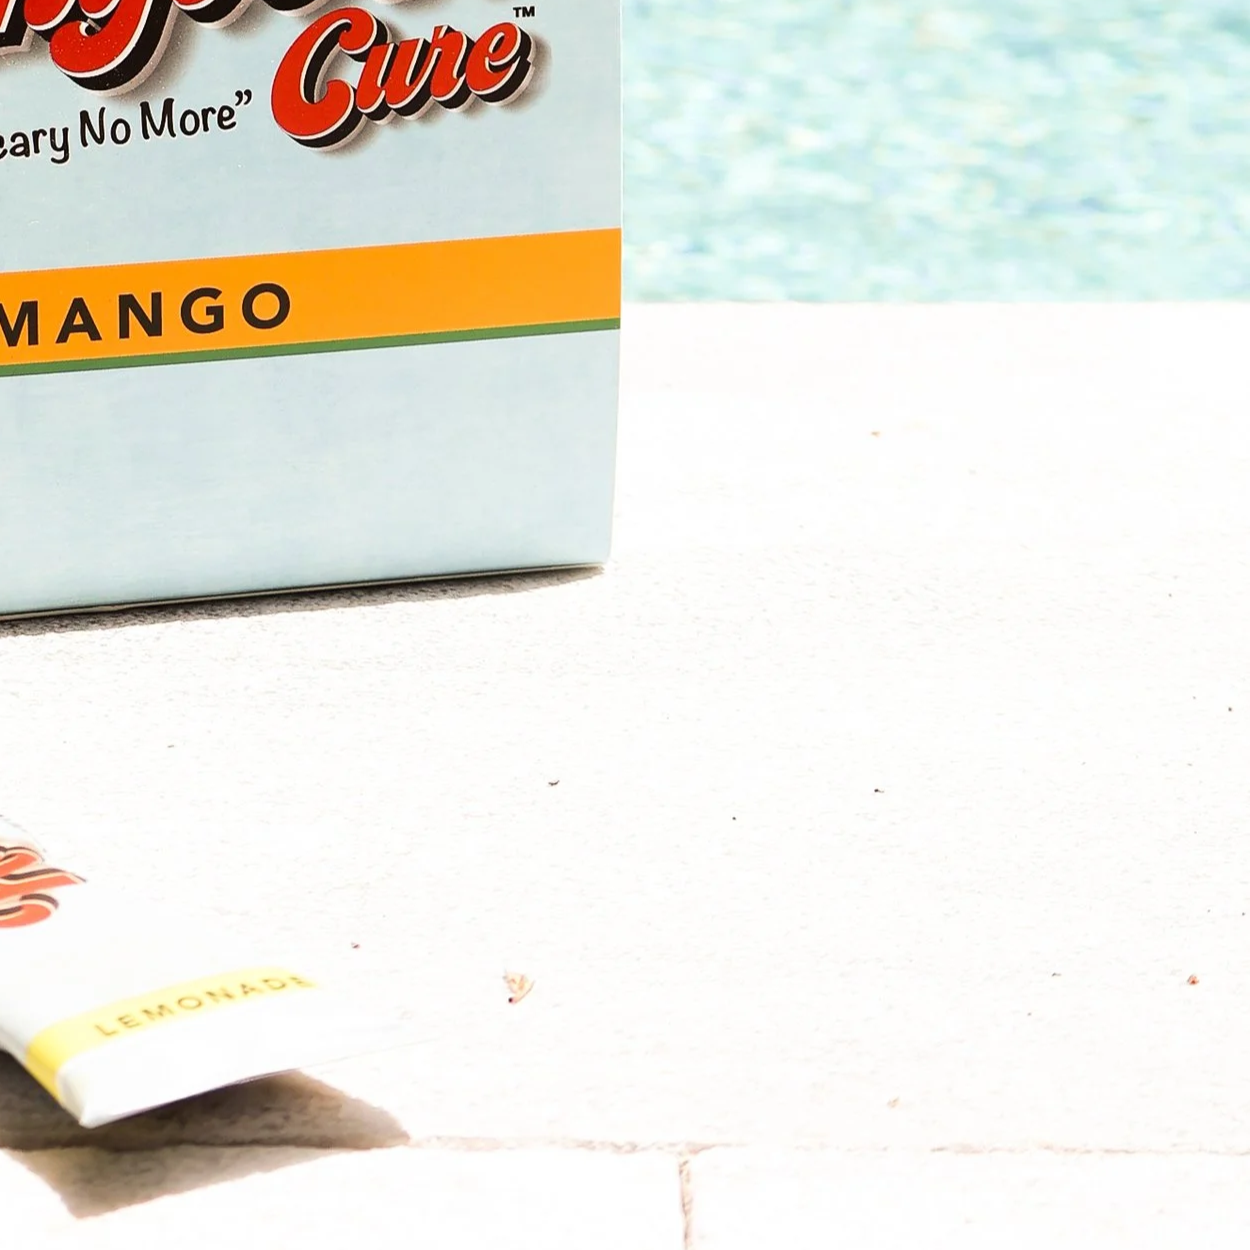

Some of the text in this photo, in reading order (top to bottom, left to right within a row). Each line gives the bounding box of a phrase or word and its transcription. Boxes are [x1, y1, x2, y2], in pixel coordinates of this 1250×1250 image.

[270, 6, 534, 149] Cure
[79, 106, 131, 147] No
[94, 973, 318, 1038] LEMONADE
